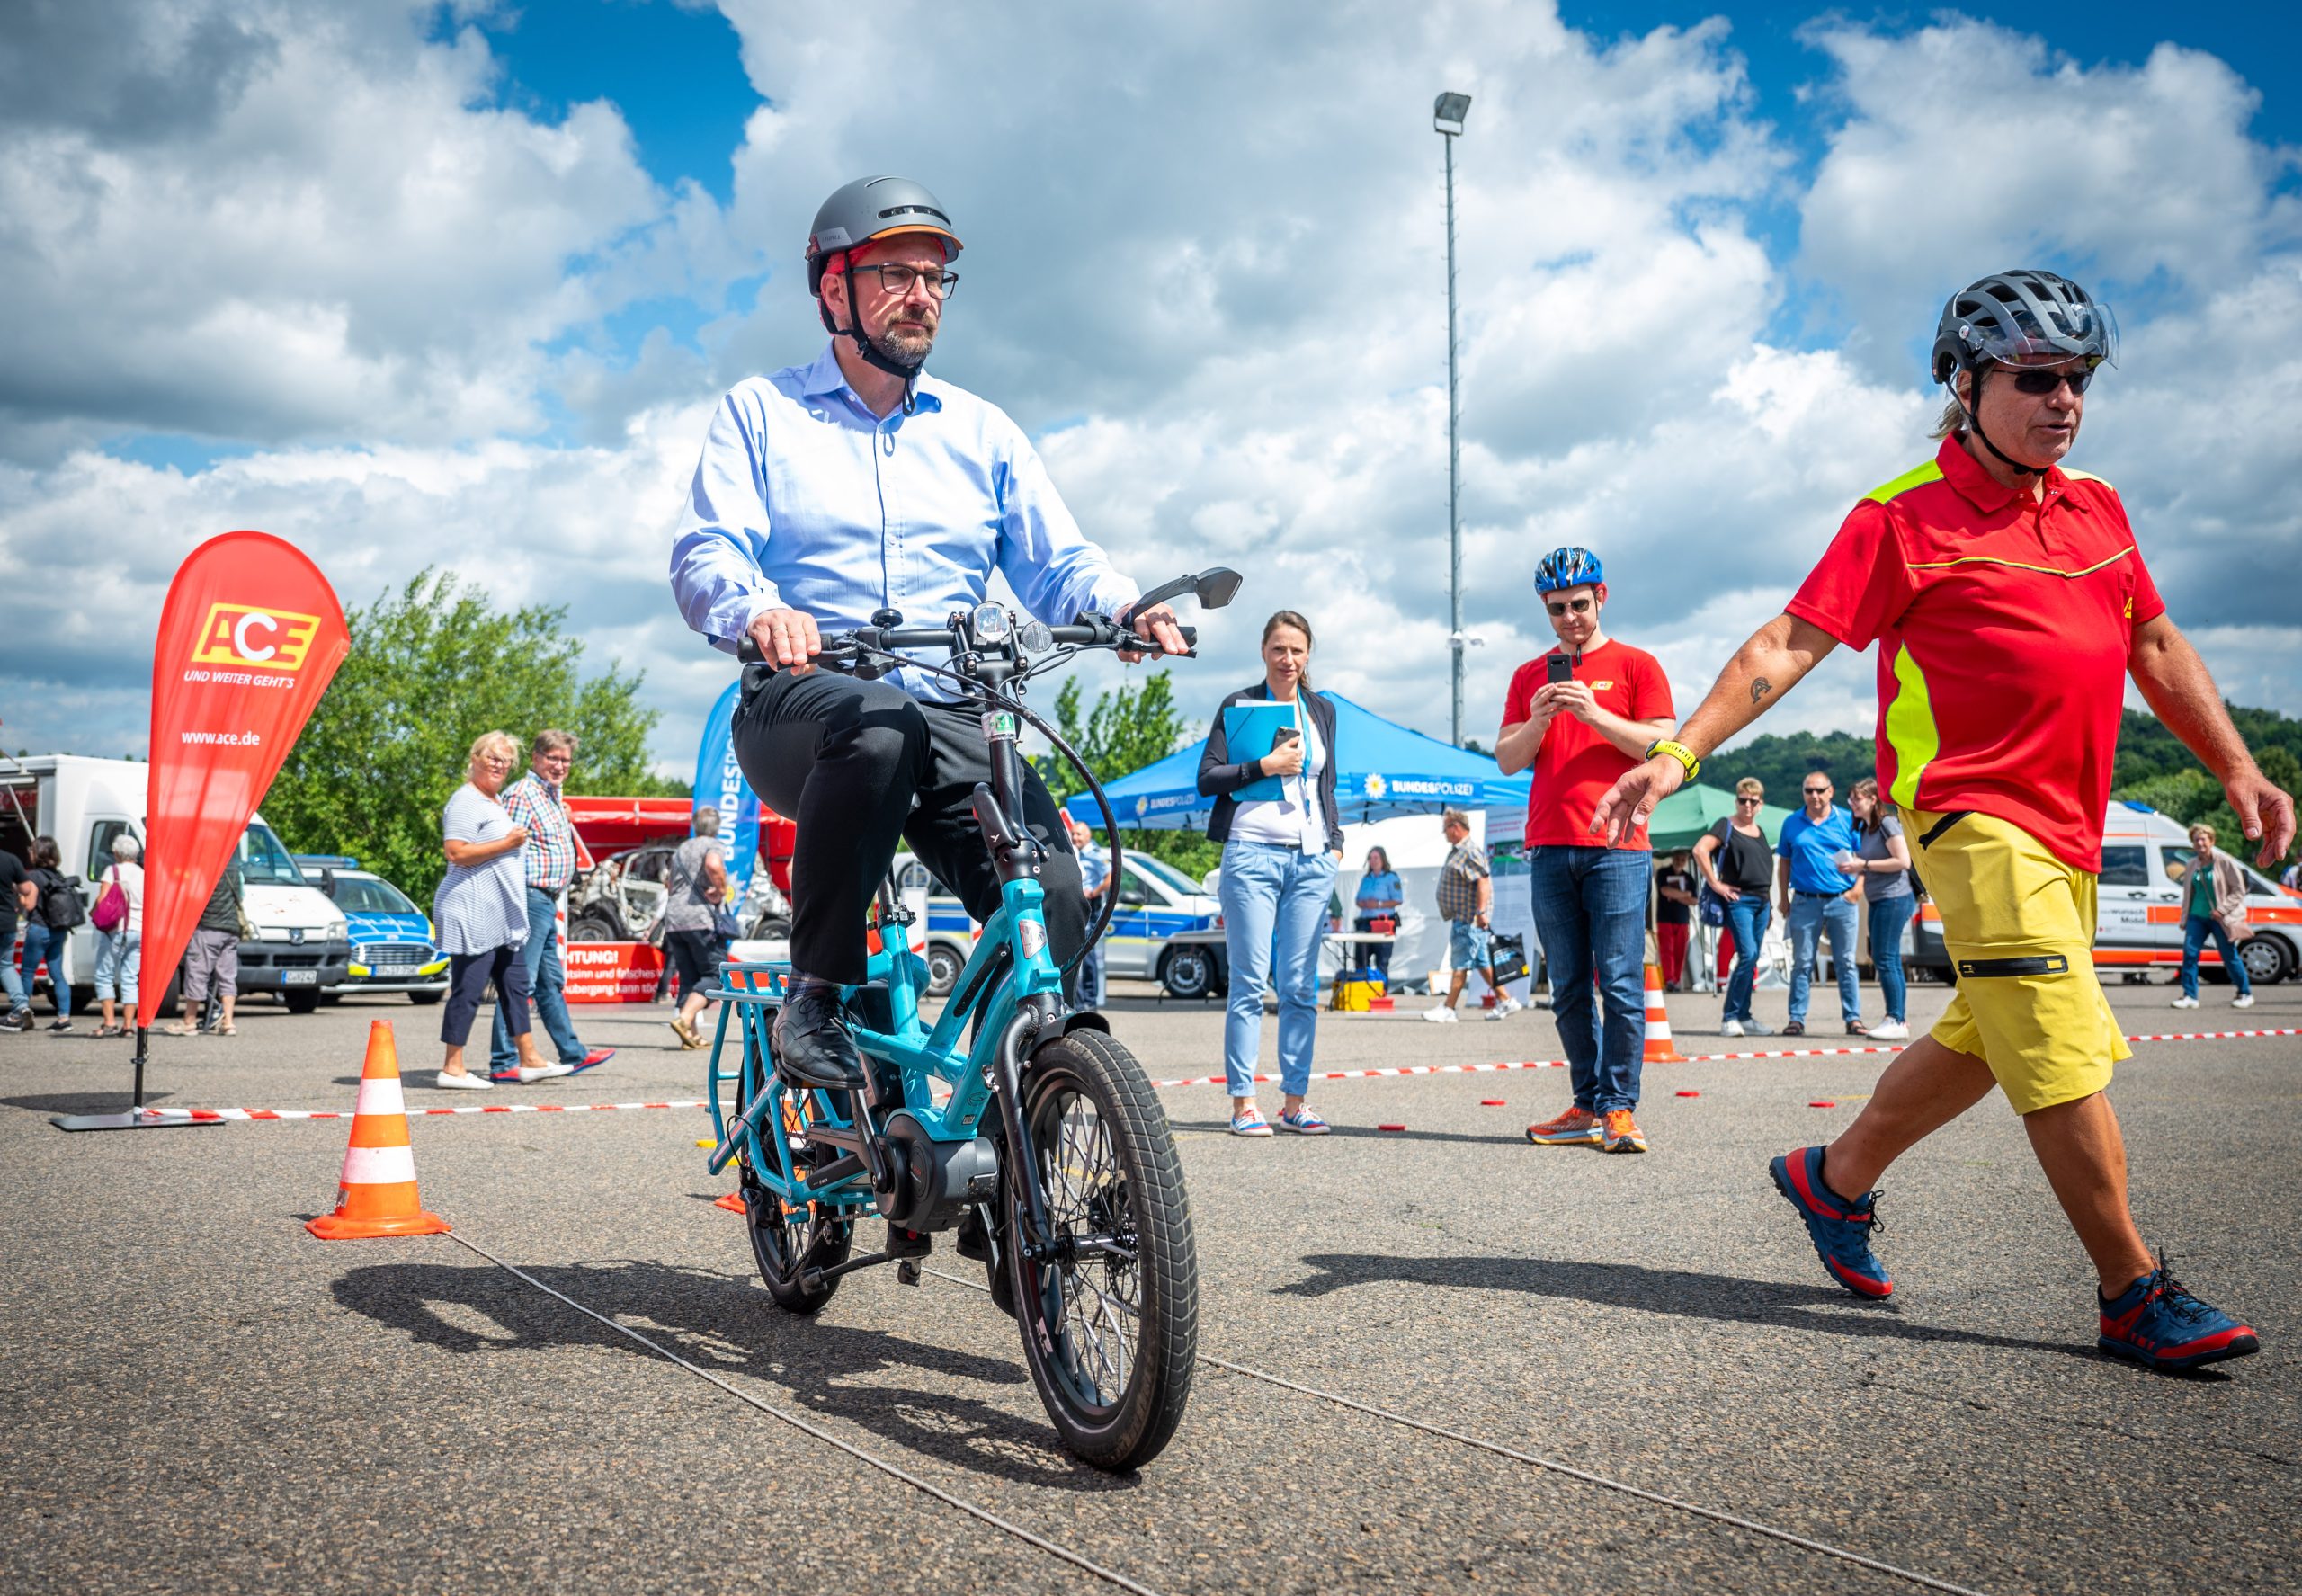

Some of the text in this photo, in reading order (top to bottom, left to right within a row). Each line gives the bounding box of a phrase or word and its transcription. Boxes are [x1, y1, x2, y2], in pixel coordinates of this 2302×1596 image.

[199, 611, 315, 664] ACE
[183, 671, 210, 682] UND
[212, 671, 253, 686] WEITER
[182, 730, 261, 745] www.ace.de
[1392, 780, 1475, 796] BUNDESPOLIZEI
[567, 950, 619, 965] HTUNG!
[567, 968, 593, 978] tsinn
[594, 968, 614, 978] und
[616, 984, 639, 993] kann
